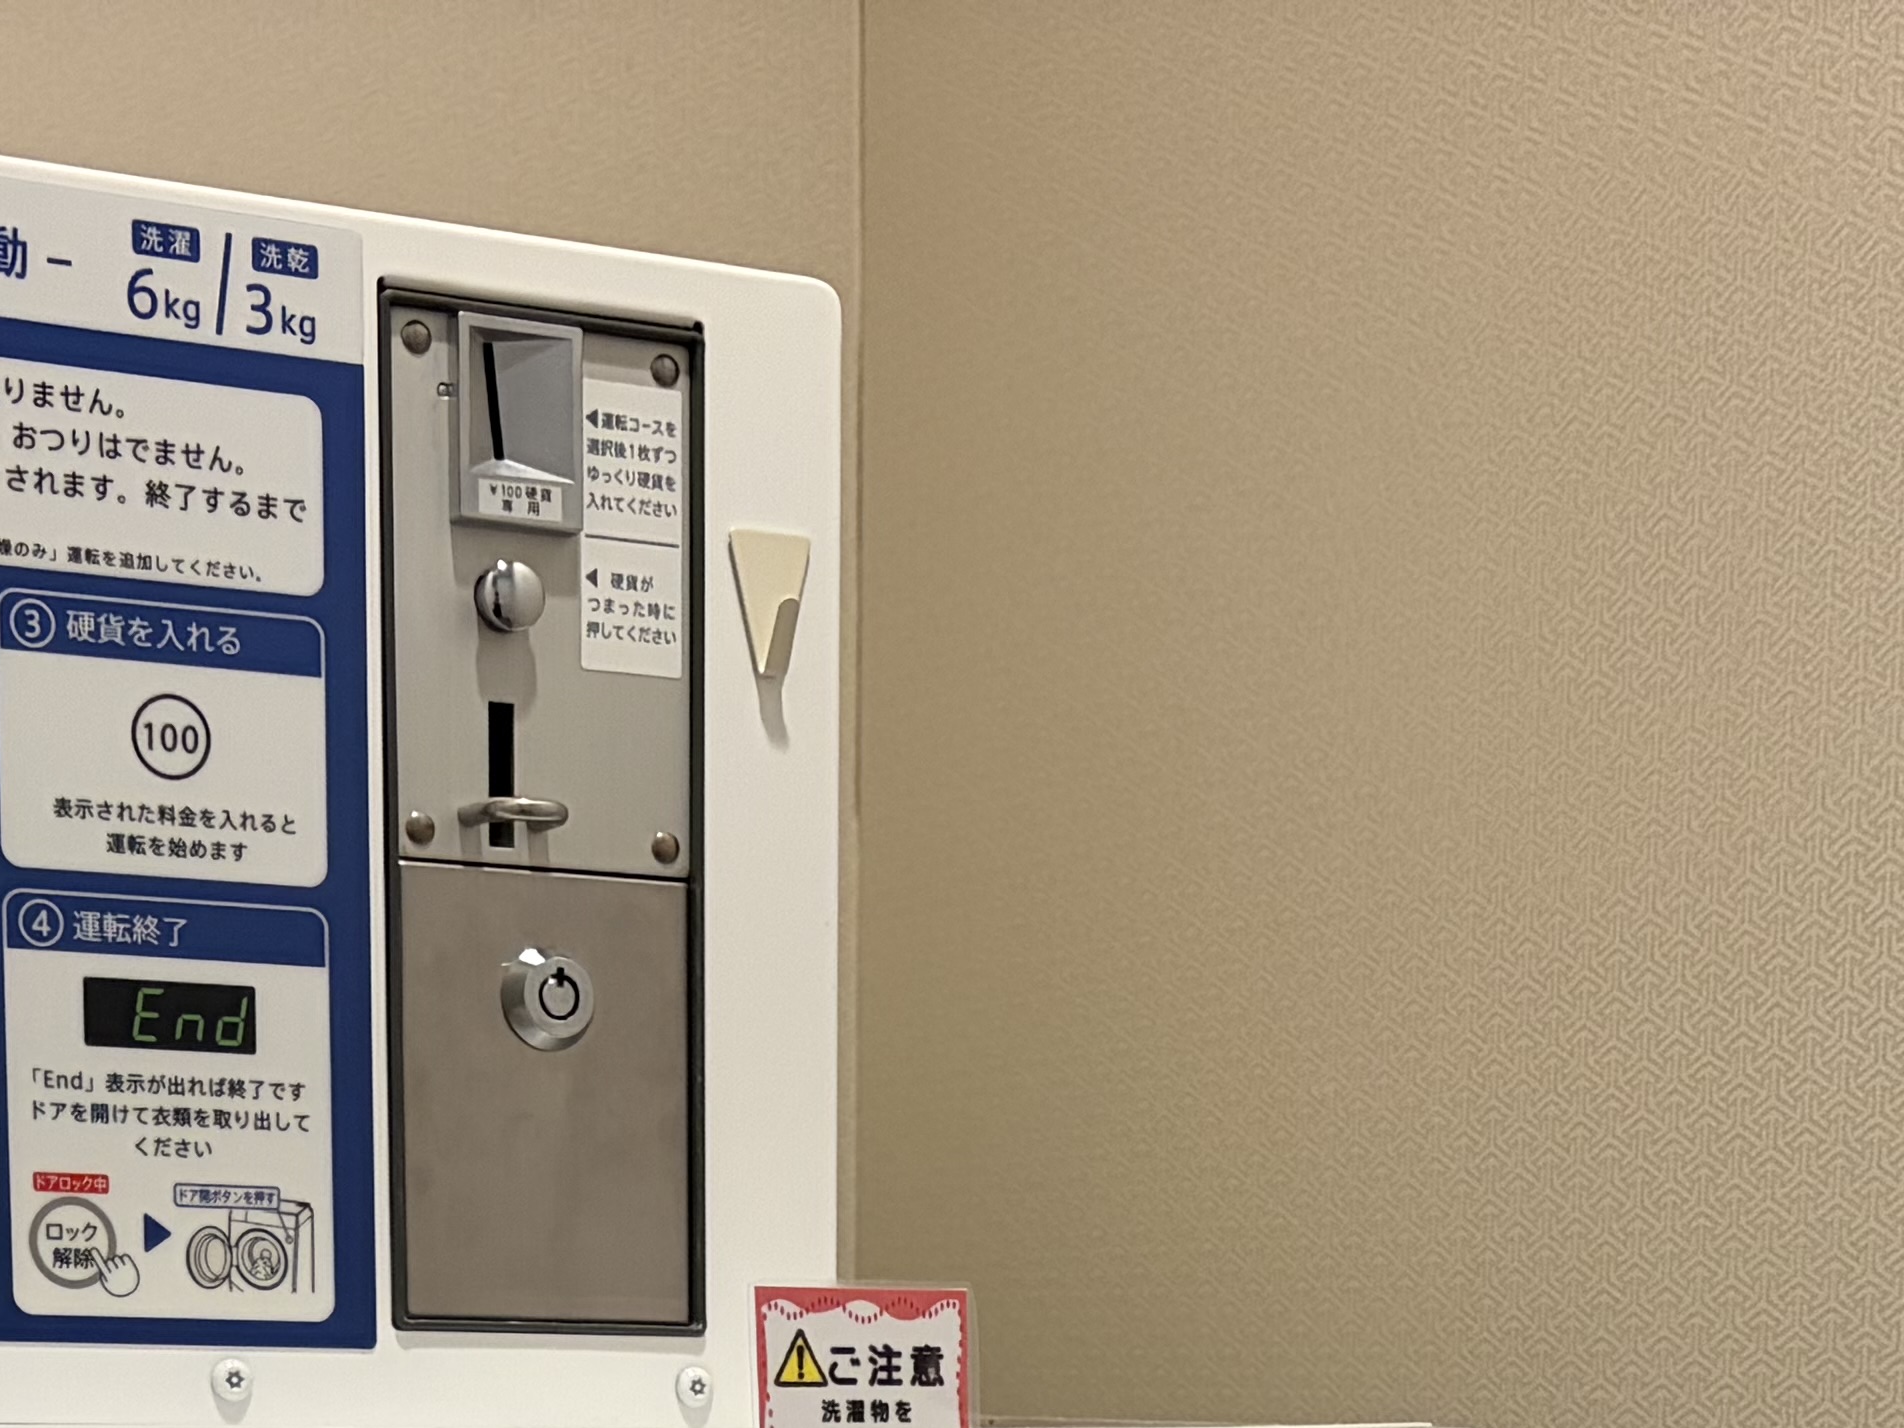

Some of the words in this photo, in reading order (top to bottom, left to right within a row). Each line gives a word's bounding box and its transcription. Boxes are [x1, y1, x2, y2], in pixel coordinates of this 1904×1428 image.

[139, 221, 194, 258] 洗濯
[260, 241, 310, 276] 洗乾
[601, 412, 678, 438] 運転コースを
[586, 464, 678, 493] ゆっくり硬貨を
[586, 492, 678, 519] 入れてください
[610, 572, 654, 594] 硬貨が
[587, 597, 677, 621] つまった時に
[66, 609, 242, 656] 硬貨を入れる
[586, 620, 677, 646] 押してください
[143, 721, 200, 755] 100
[52, 797, 298, 836] 表示された料金を入れると
[106, 832, 249, 863] 運転を始めます
[73, 908, 189, 949] 運転終了
[131, 987, 249, 1048] End
[33, 1101, 312, 1135] ドアを開けて衣類を取り出して
[134, 1136, 214, 1160] ください
[34, 1174, 109, 1195] ドアロック中
[44, 1220, 98, 1243] ロック
[51, 1247, 96, 1271] 解除
[828, 1343, 946, 1388] ご注意
[820, 1398, 913, 1424] 洗濯物を
